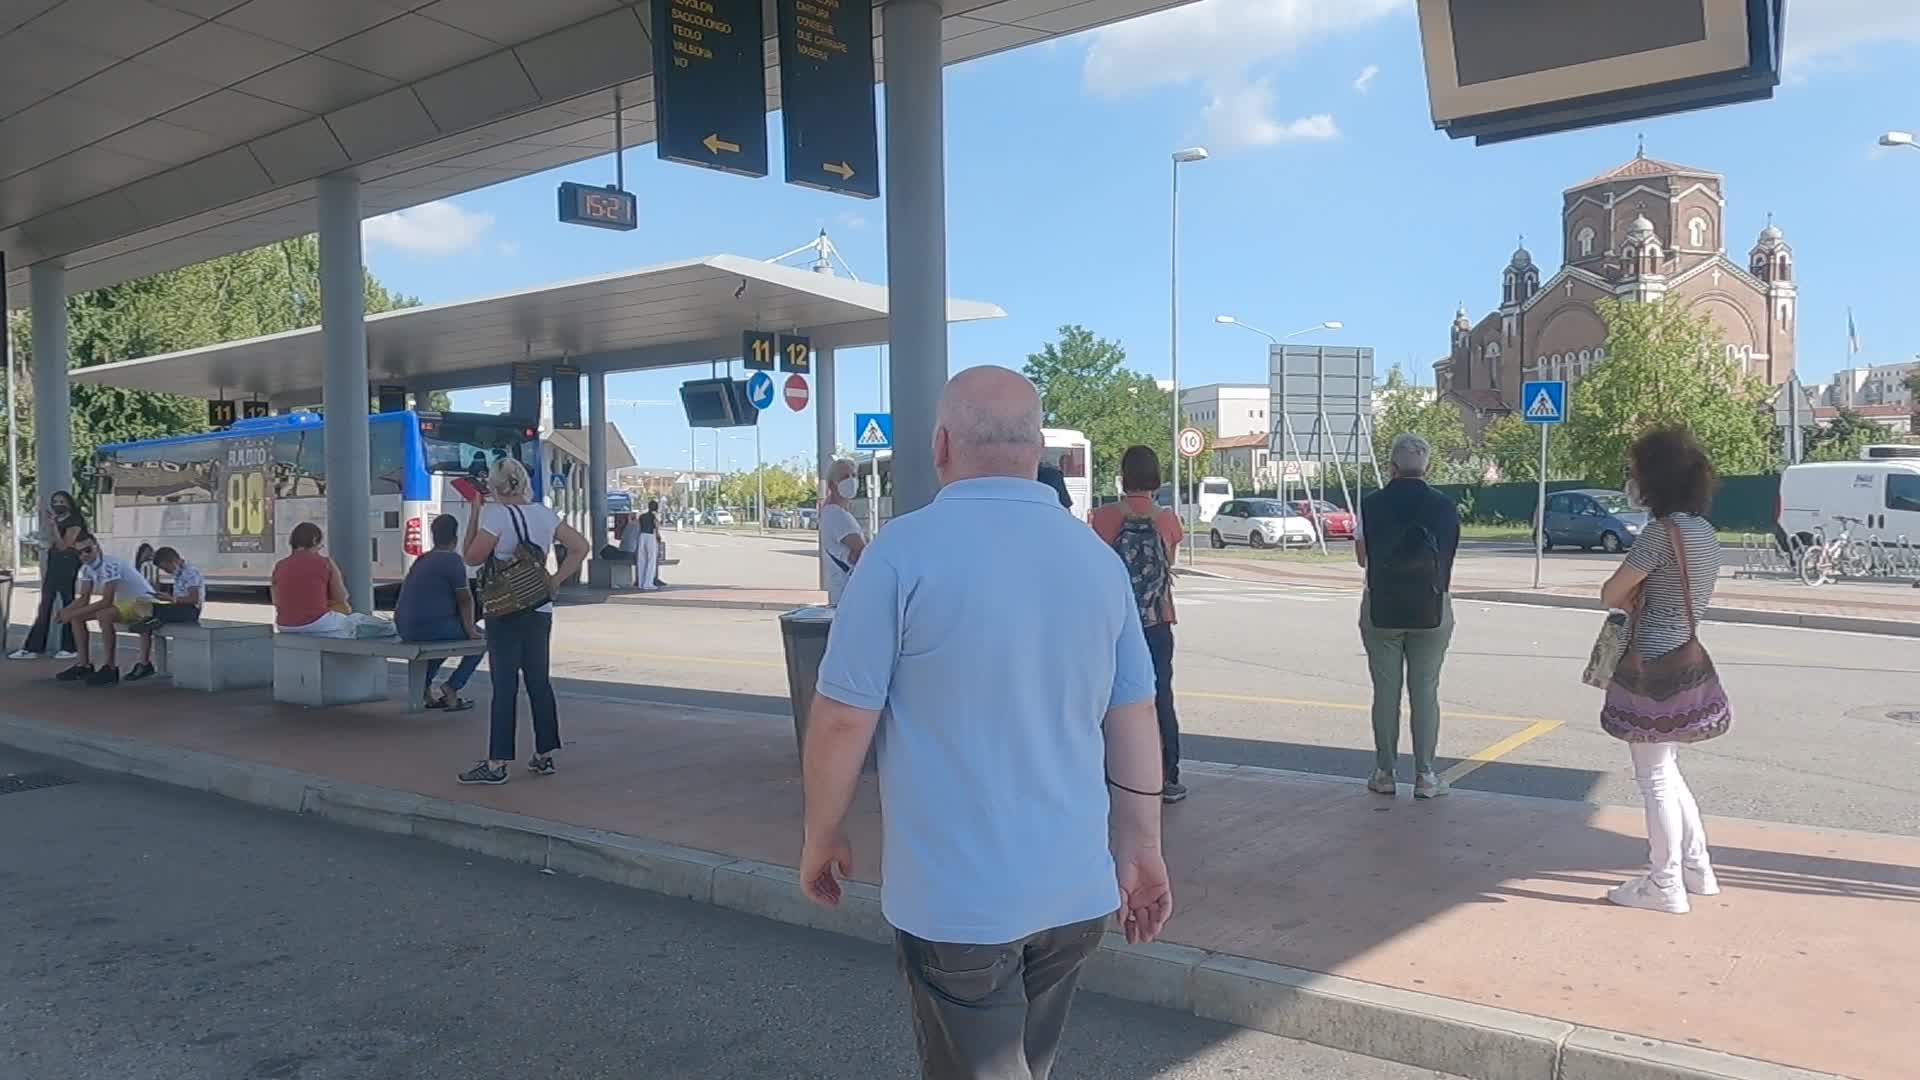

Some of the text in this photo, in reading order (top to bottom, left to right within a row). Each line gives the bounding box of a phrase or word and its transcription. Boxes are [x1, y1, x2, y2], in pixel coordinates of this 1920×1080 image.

[671, 8, 732, 34] SACCOLONGO
[673, 24, 702, 40] TEOLO
[752, 339, 807, 365] 11 12
[215, 405, 231, 420] 11
[1183, 436, 1197, 448] 10
[228, 448, 267, 466] RADIO
